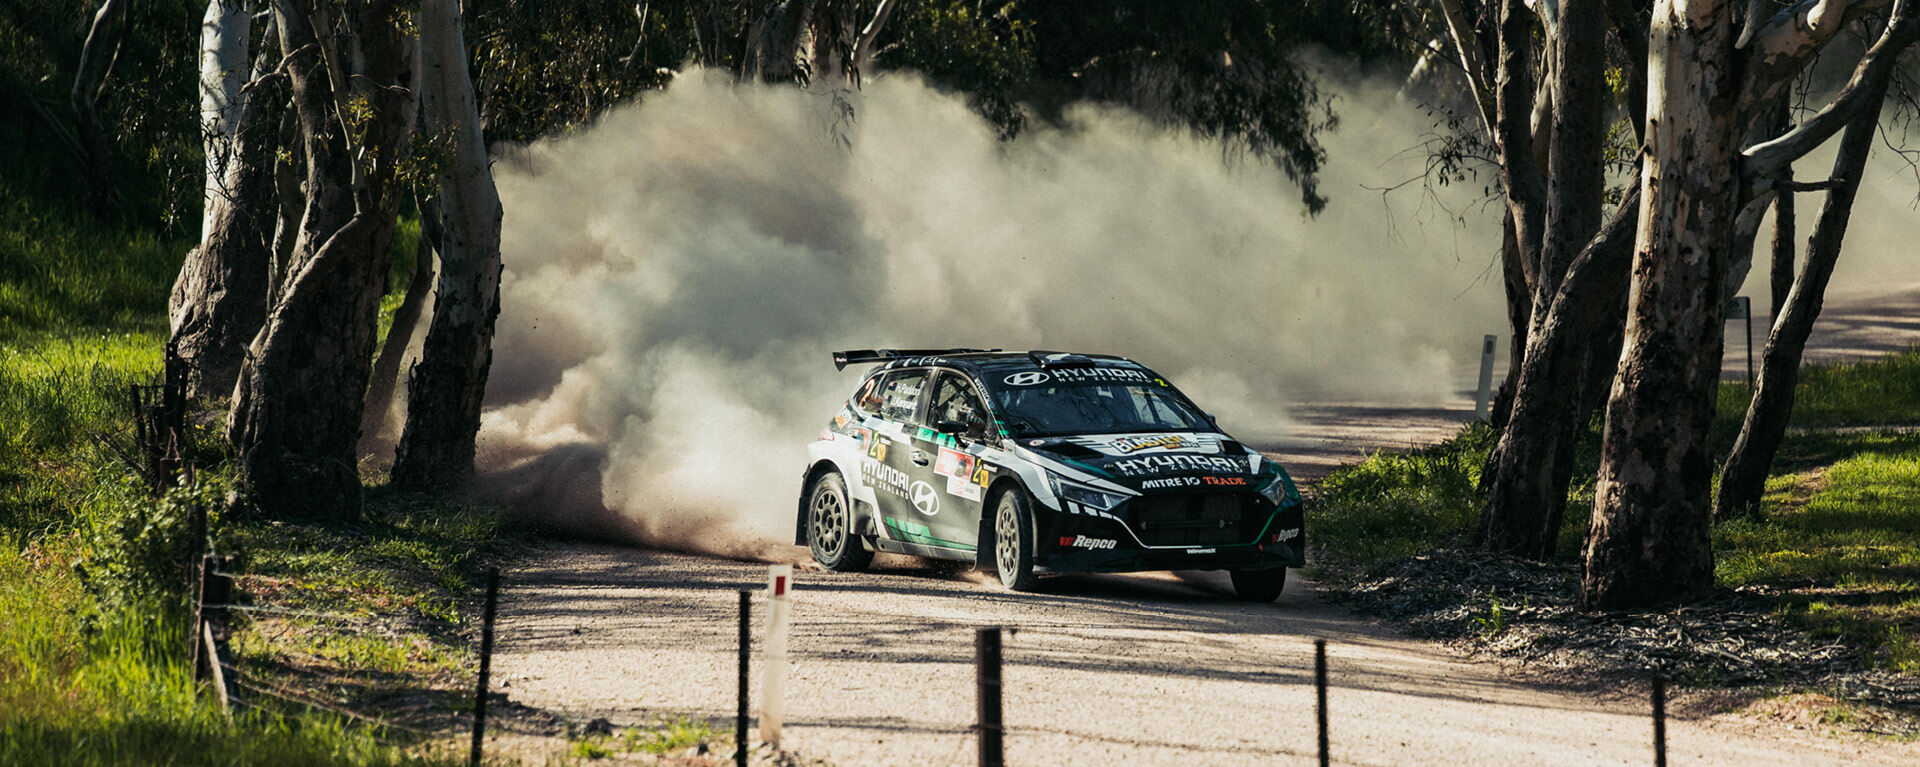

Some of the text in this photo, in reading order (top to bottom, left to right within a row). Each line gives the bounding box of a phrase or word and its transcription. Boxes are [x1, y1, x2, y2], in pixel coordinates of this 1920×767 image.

[1051, 368, 1148, 379] HYUNDAI
[1154, 378, 1169, 387] 2
[869, 432, 880, 456] 2
[972, 458, 982, 482] 2
[1115, 455, 1240, 471] HYUNDAI
[1124, 464, 1243, 477] NEW ZEALAND
[862, 459, 910, 492] HYUNDAI
[1142, 476, 1247, 489] MITRE 10 TRADE
[1072, 534, 1118, 550] Repco
